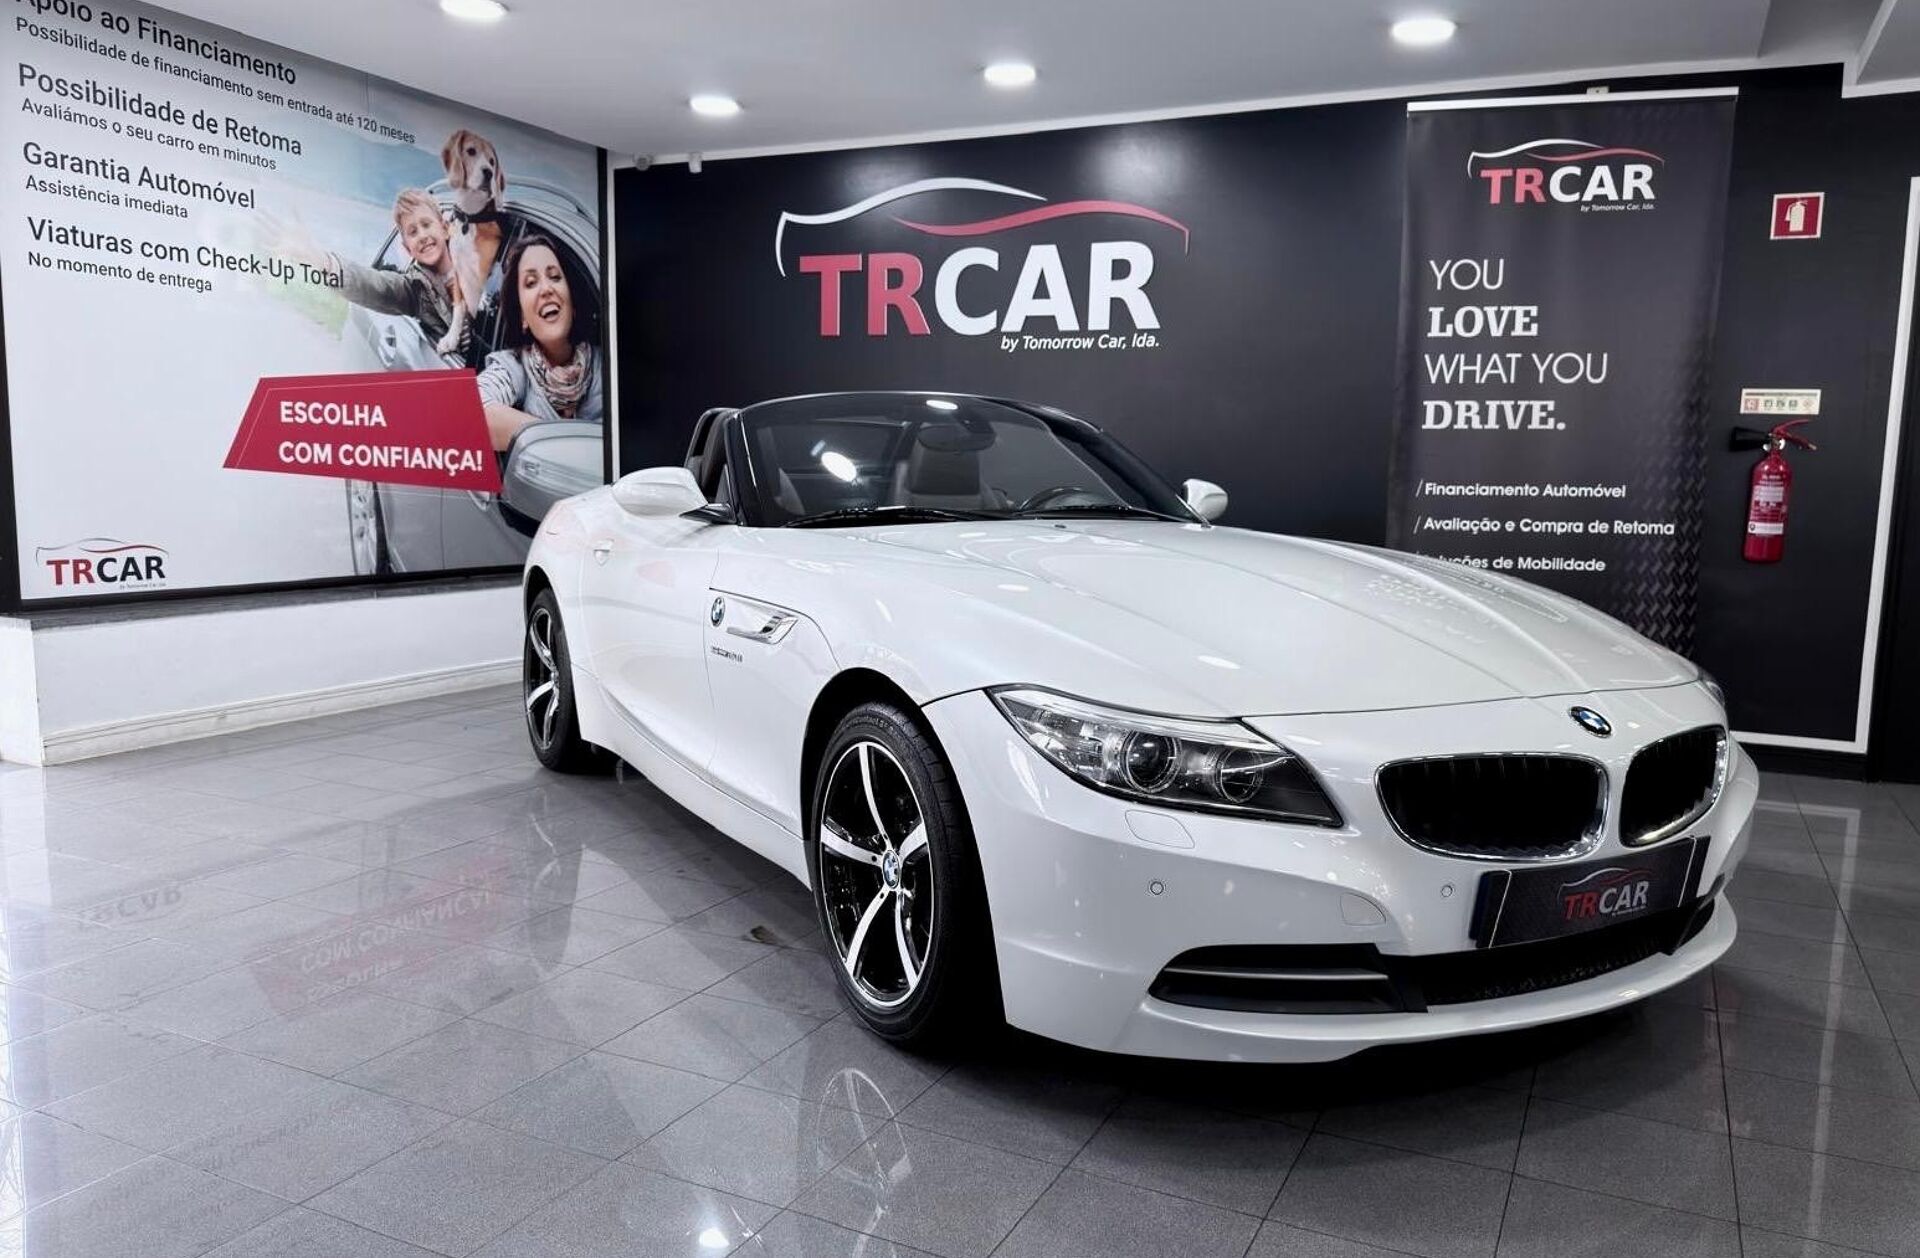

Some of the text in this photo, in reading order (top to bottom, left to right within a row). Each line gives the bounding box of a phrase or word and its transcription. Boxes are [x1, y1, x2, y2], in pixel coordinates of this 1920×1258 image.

[16, 0, 297, 85] poio ao Financiamento
[16, 16, 415, 144] Possibilidade de financiamento sem entrada até 120 meses
[19, 63, 302, 156] Possibilidade de Retoma
[22, 98, 276, 171] Avaliámos o seu carro em minutos
[23, 142, 254, 209] Garantia Automóvel
[1480, 163, 1656, 205] TRCAR
[26, 175, 188, 219] Assistência imediata
[27, 216, 344, 290] Viaturas com Check-Up Total
[28, 251, 212, 293] No momento de entrega
[799, 240, 1161, 336] TRCAR
[1429, 259, 1505, 291] YOU
[1427, 305, 1539, 338] LOVE
[1000, 335, 1018, 352] by
[1023, 335, 1095, 349] Tomorrow
[1098, 333, 1126, 349] Car,
[1424, 352, 1608, 384] WHAT YOU
[279, 400, 387, 428] ESCOLHA
[1421, 400, 1567, 431] DRIVE.
[278, 441, 484, 477] COM CONFIANÇA!
[1543, 483, 1627, 499] Automóvel
[1505, 521, 1515, 532] e
[1519, 518, 1583, 535] Compra
[1588, 519, 1609, 534] de
[1613, 520, 1676, 535] Retoma
[46, 555, 166, 586] TRCAR
[1493, 556, 1514, 570] de
[1517, 556, 1606, 572] Mobilidade
[1567, 882, 1647, 919] TRCAR
